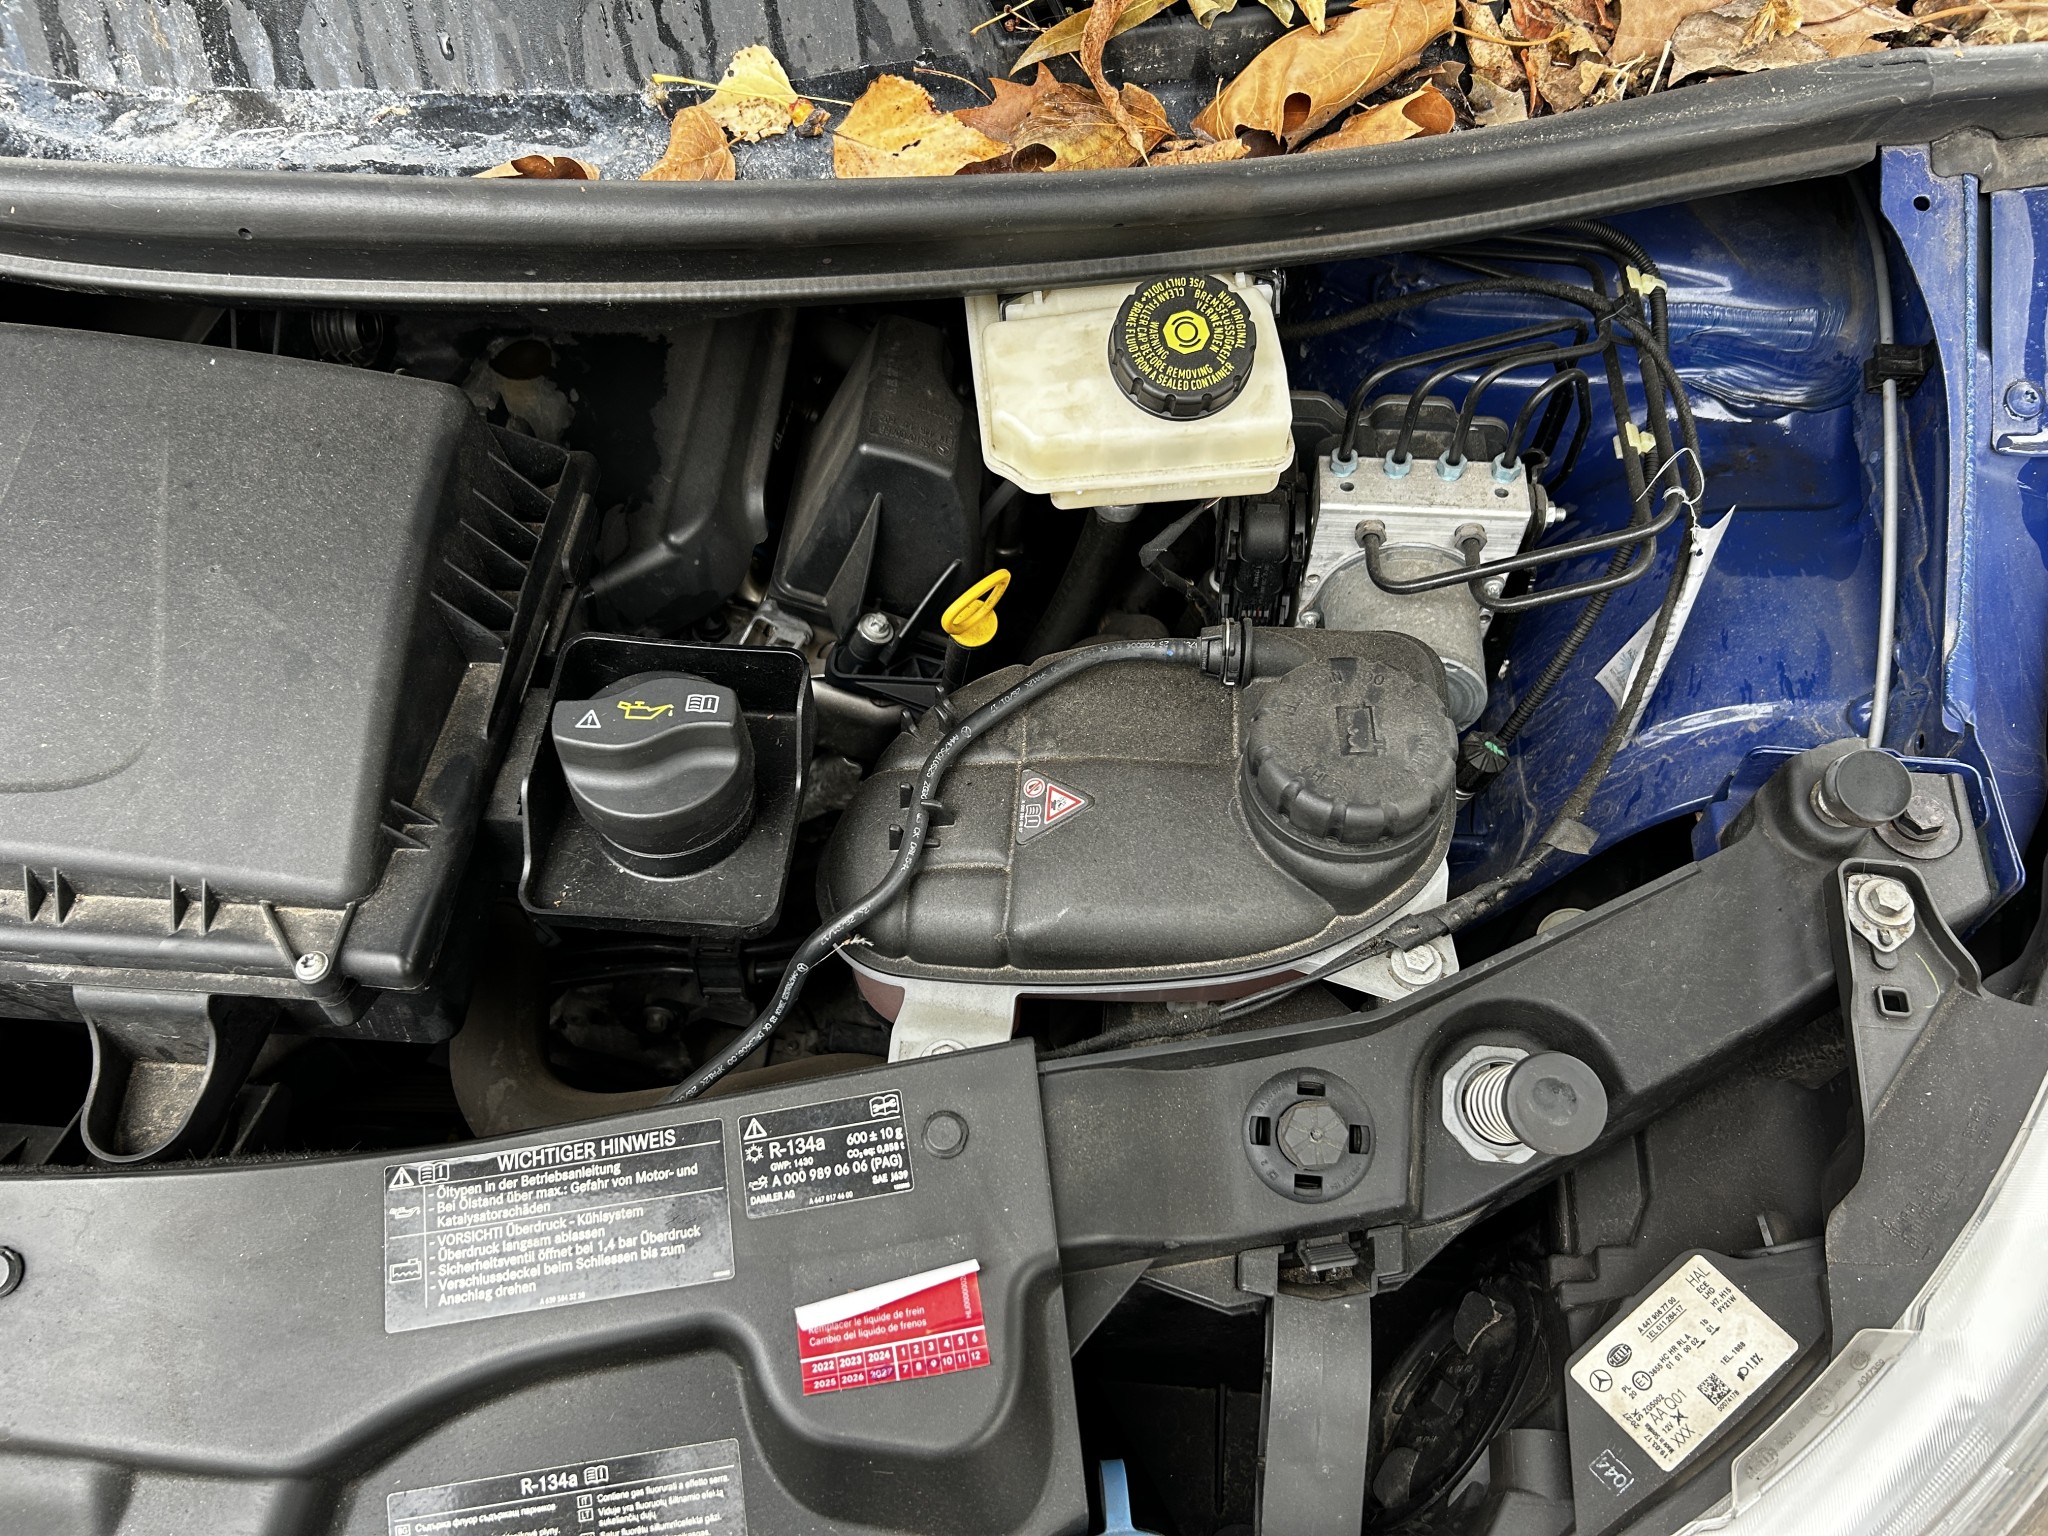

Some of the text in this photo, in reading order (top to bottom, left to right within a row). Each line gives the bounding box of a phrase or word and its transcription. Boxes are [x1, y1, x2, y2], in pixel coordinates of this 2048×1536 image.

[1166, 278, 1186, 289] ONLY
[1190, 278, 1205, 289] USE
[1194, 290, 1235, 364] BREMSFLÜSSIGKEIT
[1196, 301, 1224, 353] VERWENDEN
[1218, 291, 1246, 348] NUR ORIGINAL
[1126, 302, 1234, 390] BRAKE FLUID FROM A SEALED CONTAINER
[1137, 288, 1213, 378] CLEAN FILLER CAP BEFORE REMOVING
[1149, 321, 1169, 360] WARNING
[496, 1129, 676, 1172] WICHTIGER HINWEIS
[769, 1136, 826, 1159] R-134a
[846, 1131, 868, 1146] 600
[880, 1127, 893, 1140] 10
[895, 1127, 903, 1140] g
[770, 1156, 814, 1172] GWP: 1430
[772, 1153, 902, 1188] A 000 989 06 06 (PAG)
[436, 1163, 621, 1200] Öltypen in der Betriebsanleitung
[437, 1199, 456, 1214] Bei
[458, 1193, 504, 1210] Ölstand
[506, 1190, 532, 1204] über
[570, 1178, 609, 1194] Gefahr
[611, 1175, 632, 1188] von
[635, 1169, 674, 1184] Motor-
[676, 1162, 698, 1177] und
[872, 1173, 888, 1184] SAE
[750, 1189, 795, 1206] DAIMLER AG
[437, 1202, 550, 1228] Katalysatorschäden
[506, 1217, 567, 1237] Überdruck
[577, 1207, 644, 1226] Kühlsystem
[438, 1227, 605, 1262] Überdruck langsam ablassen
[438, 1250, 535, 1277] Sicherheitsventil
[538, 1245, 573, 1261] öffnet
[575, 1241, 593, 1256] bei
[618, 1236, 638, 1248] bar
[640, 1224, 701, 1245] Überdruck
[437, 1244, 685, 1291] Verschlussdeckel beim Schliessen bis zum
[1685, 1267, 1710, 1287] HAL
[438, 1282, 536, 1307] Anschlag drehen
[1696, 1281, 1710, 1294] ECE
[1702, 1287, 1715, 1300] LHD
[854, 1318, 862, 1326] le
[864, 1312, 891, 1325] liquide
[893, 1310, 903, 1319] de
[905, 1307, 924, 1317] frein
[1642, 1318, 1652, 1328] 447
[1660, 1302, 1668, 1311] 77
[1668, 1297, 1676, 1305] 00
[1717, 1294, 1736, 1314] PY21W
[809, 1319, 927, 1346] Cambio del de frenos
[1646, 1330, 1658, 1340] 1EL
[1706, 1325, 1714, 1333] 01
[812, 1334, 978, 1373] 2022 2023 2024 1 2 3 4 5 6
[1608, 1343, 1632, 1366] HELLA
[1634, 1373, 1650, 1388] E1
[1659, 1353, 1670, 1363] HC
[1668, 1345, 1678, 1355] HR
[1676, 1339, 1687, 1347] RL
[1666, 1337, 1699, 1369] 01 01 00 02
[814, 1378, 836, 1389] 2025
[842, 1373, 864, 1384] 2026
[903, 1364, 908, 1372] 7
[916, 1362, 922, 1370] 8
[930, 1359, 936, 1367] 9
[943, 1356, 952, 1365] 10
[958, 1354, 966, 1363] 11
[971, 1351, 980, 1360] 12
[1621, 1385, 1632, 1393] PL
[1628, 1390, 1637, 1399] 20
[1630, 1408, 1644, 1422] SK
[1642, 1394, 1664, 1415] ZGS002
[1650, 1407, 1668, 1425] AA
[1664, 1388, 1687, 1410] Q01
[1662, 1421, 1674, 1434] 12V
[520, 1472, 578, 1496] R-134a
[630, 1488, 644, 1499] gas
